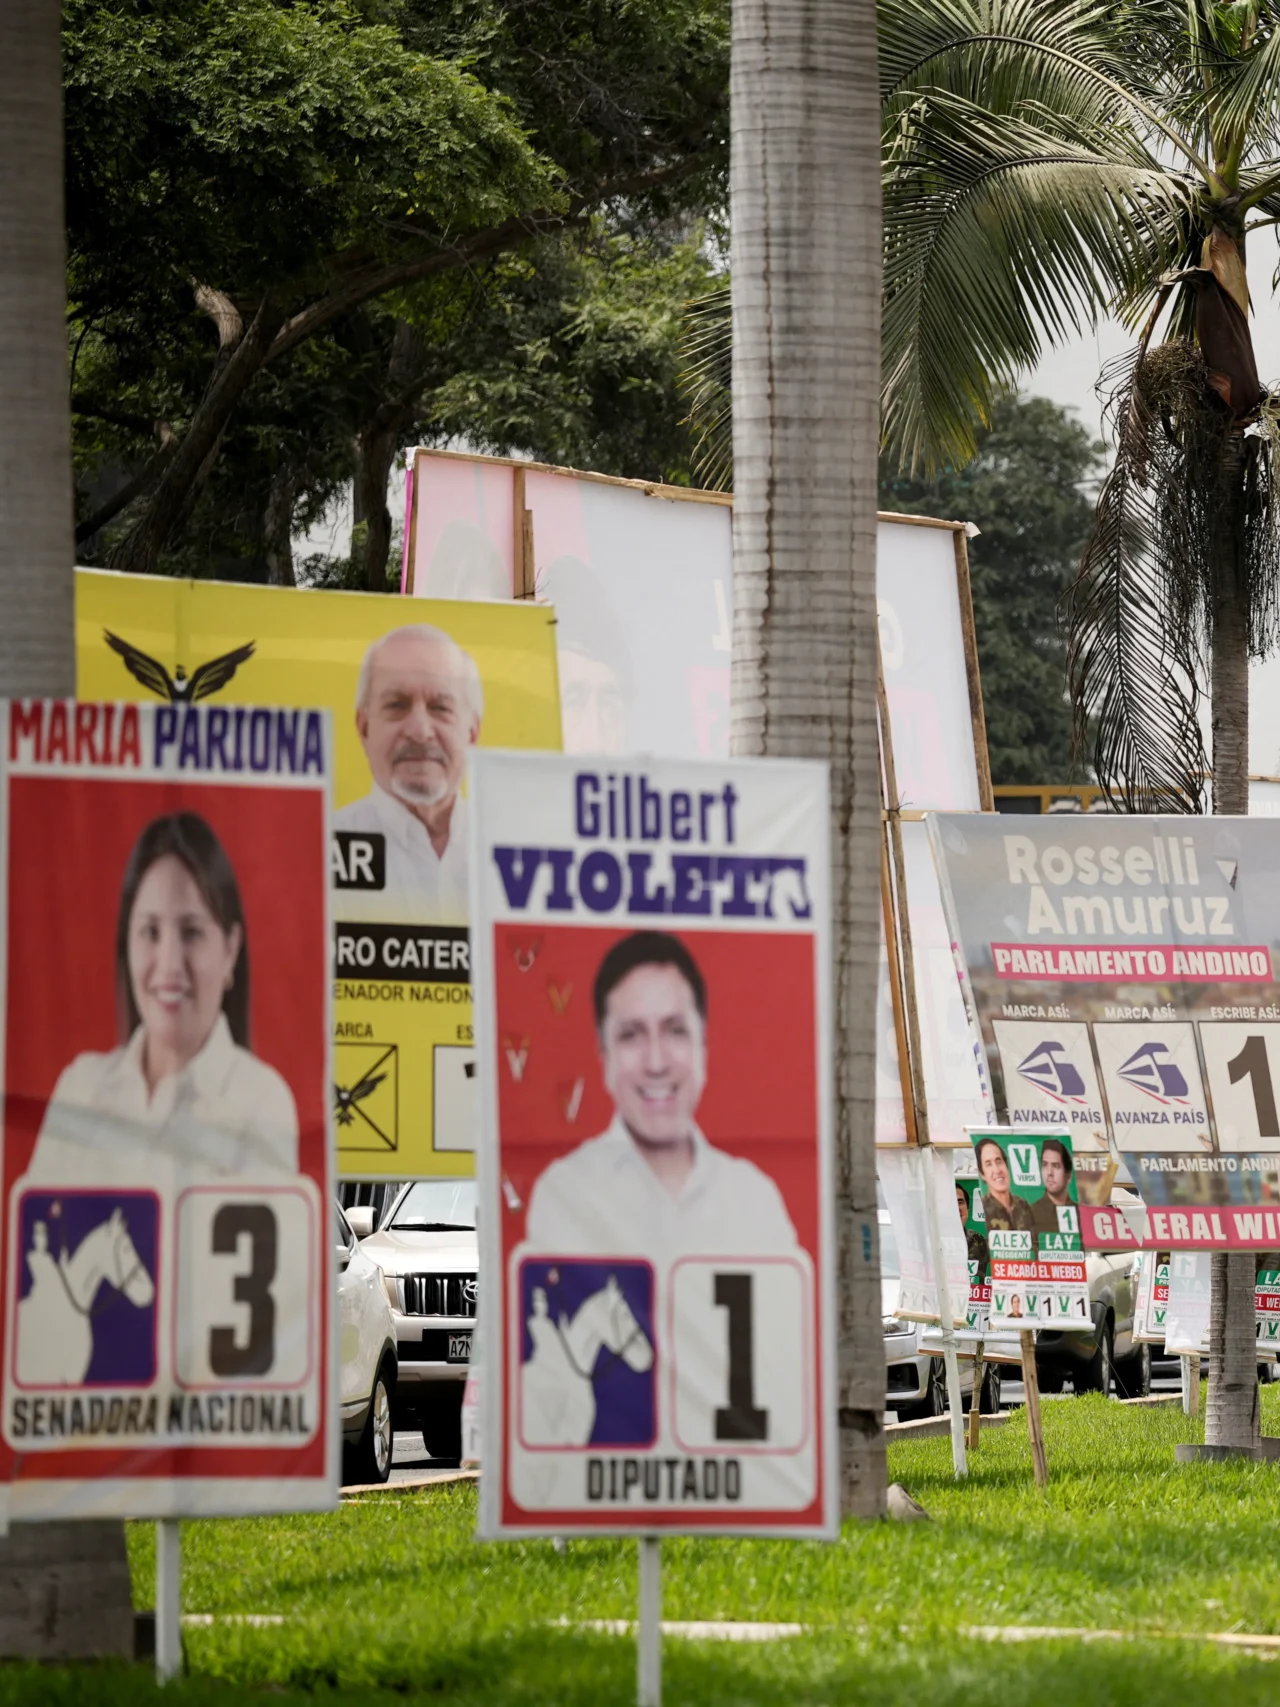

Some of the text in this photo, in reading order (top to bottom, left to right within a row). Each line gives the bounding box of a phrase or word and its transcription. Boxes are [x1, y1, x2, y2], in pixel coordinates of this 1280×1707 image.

[8, 701, 326, 776] MARIA PARIONA
[575, 772, 738, 844] Gilbert
[1003, 834, 1200, 886] Rosselli
[1027, 886, 1235, 936] Amuruz
[995, 949, 1269, 977] PARLAMENTO ANDINO
[1003, 1005, 1047, 1019] MARCA
[1105, 1006, 1149, 1020] MARCA
[1211, 1004, 1280, 1019] ESCRIBE ASÍ:
[1227, 1035, 1280, 1138] 1
[1013, 1107, 1102, 1124] AVANZA PAÍS
[1115, 1108, 1205, 1125] AVANZA PAÍS
[1013, 1148, 1031, 1173] V
[1140, 1157, 1238, 1173] PARLAMENTO
[1017, 1174, 1037, 1183] VERDE
[1062, 1208, 1073, 1231] 1
[992, 1233, 1074, 1250] ALEX LAY
[993, 1250, 1083, 1261] PRESIDENTE DIPUTADO LIMA
[994, 1261, 1083, 1280] SE ACABÓ EL WEBEO
[208, 1203, 278, 1378] 3
[995, 1294, 1006, 1311] V
[1026, 1294, 1038, 1312] V
[1043, 1296, 1052, 1317] 1
[1058, 1295, 1070, 1313] V
[1076, 1296, 1087, 1317] 1
[1267, 1322, 1279, 1336] V
[713, 1273, 769, 1442] 1
[12, 1395, 310, 1438] SENADORA NACIONAL
[586, 1457, 742, 1501] DIPUTADO
